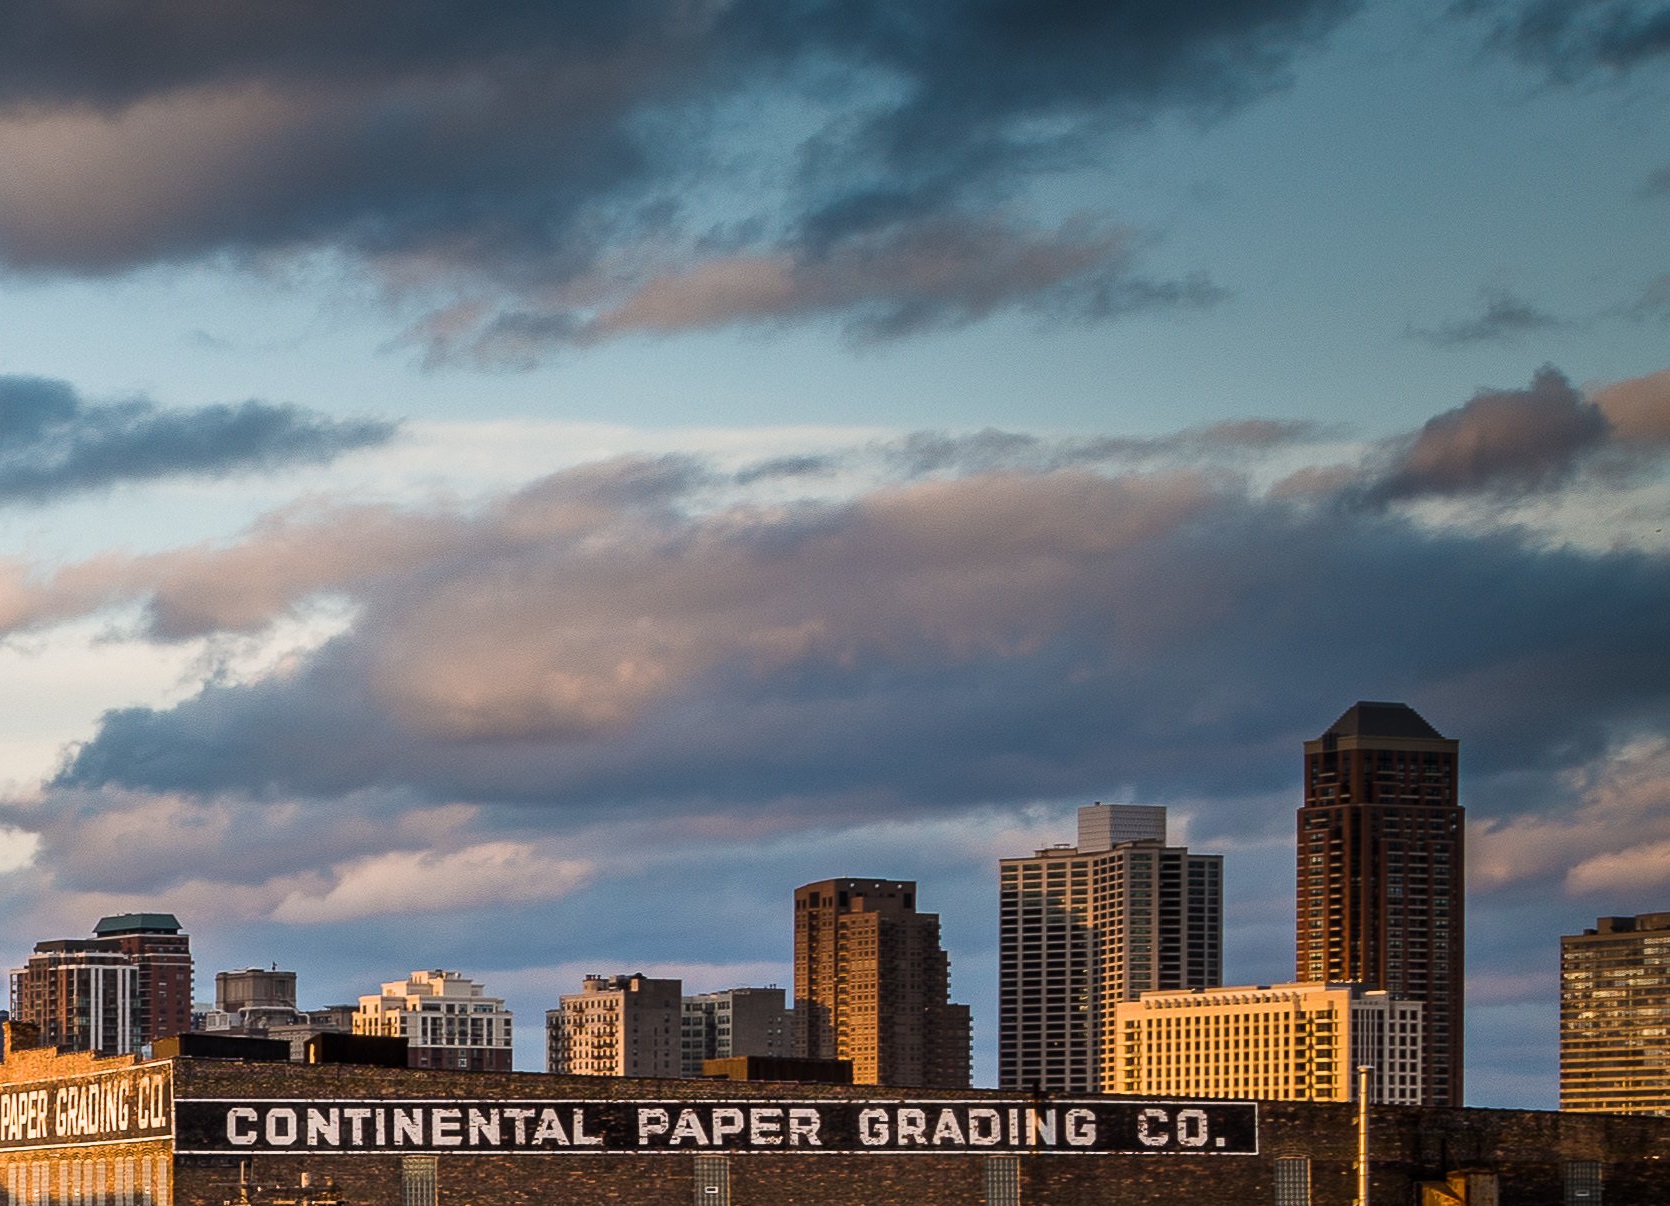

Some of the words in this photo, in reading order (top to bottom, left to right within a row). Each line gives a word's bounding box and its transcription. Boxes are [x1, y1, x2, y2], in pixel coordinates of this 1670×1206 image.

[0, 1090, 48, 1141] PAPER
[55, 1080, 129, 1137] GRADING
[137, 1075, 166, 1129] CO.
[226, 1107, 602, 1147] CONTINENTAL
[638, 1107, 821, 1146] PAPER
[858, 1107, 1096, 1147] GRADING
[1137, 1107, 1225, 1147] CO.
